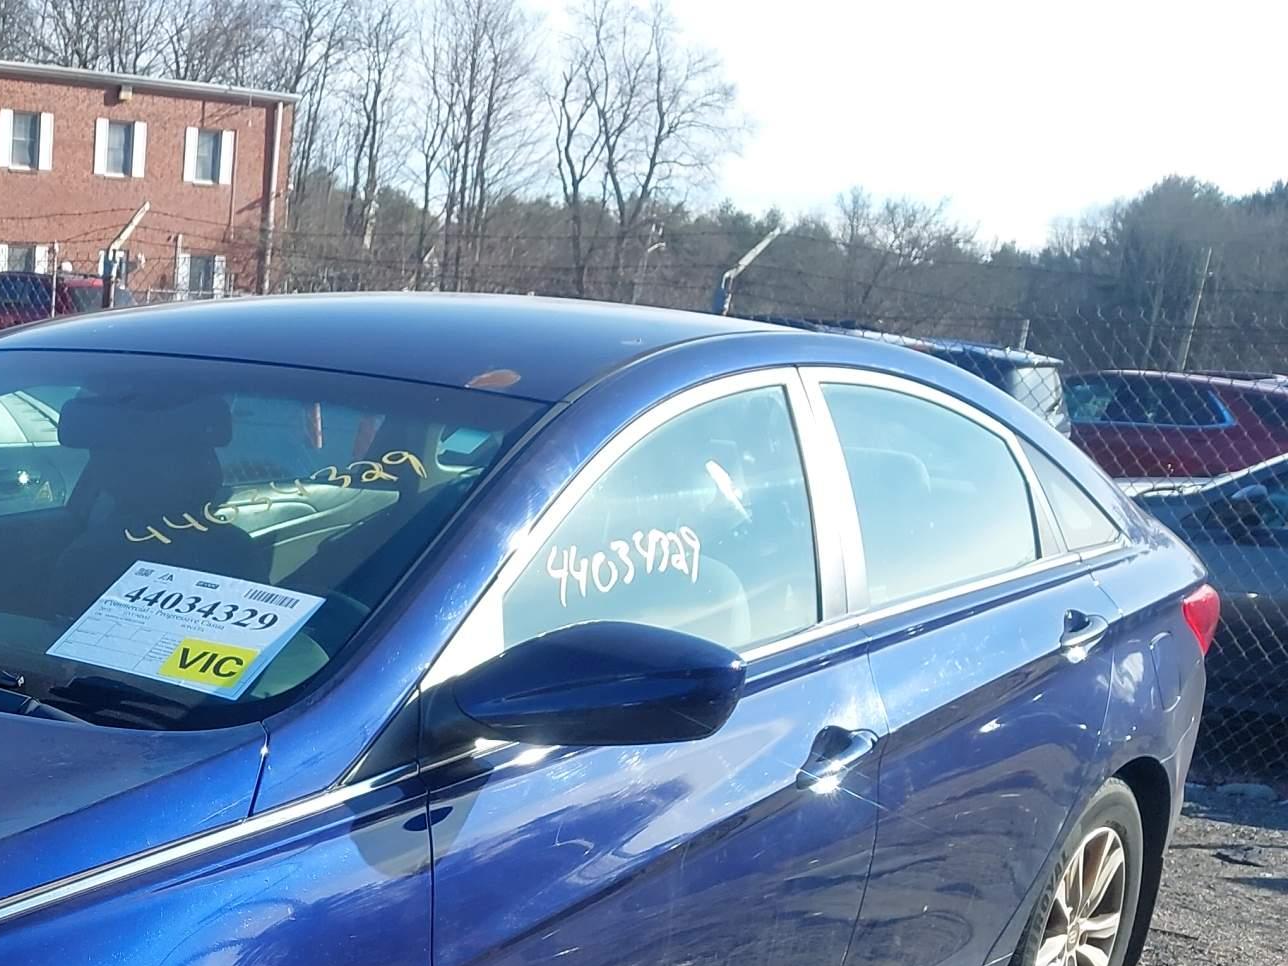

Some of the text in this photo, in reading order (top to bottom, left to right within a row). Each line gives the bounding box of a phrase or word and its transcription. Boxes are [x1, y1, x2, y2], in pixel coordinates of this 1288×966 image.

[545, 526, 701, 608] 44034329
[123, 585, 281, 631] 44034329
[177, 646, 244, 678] VIC
